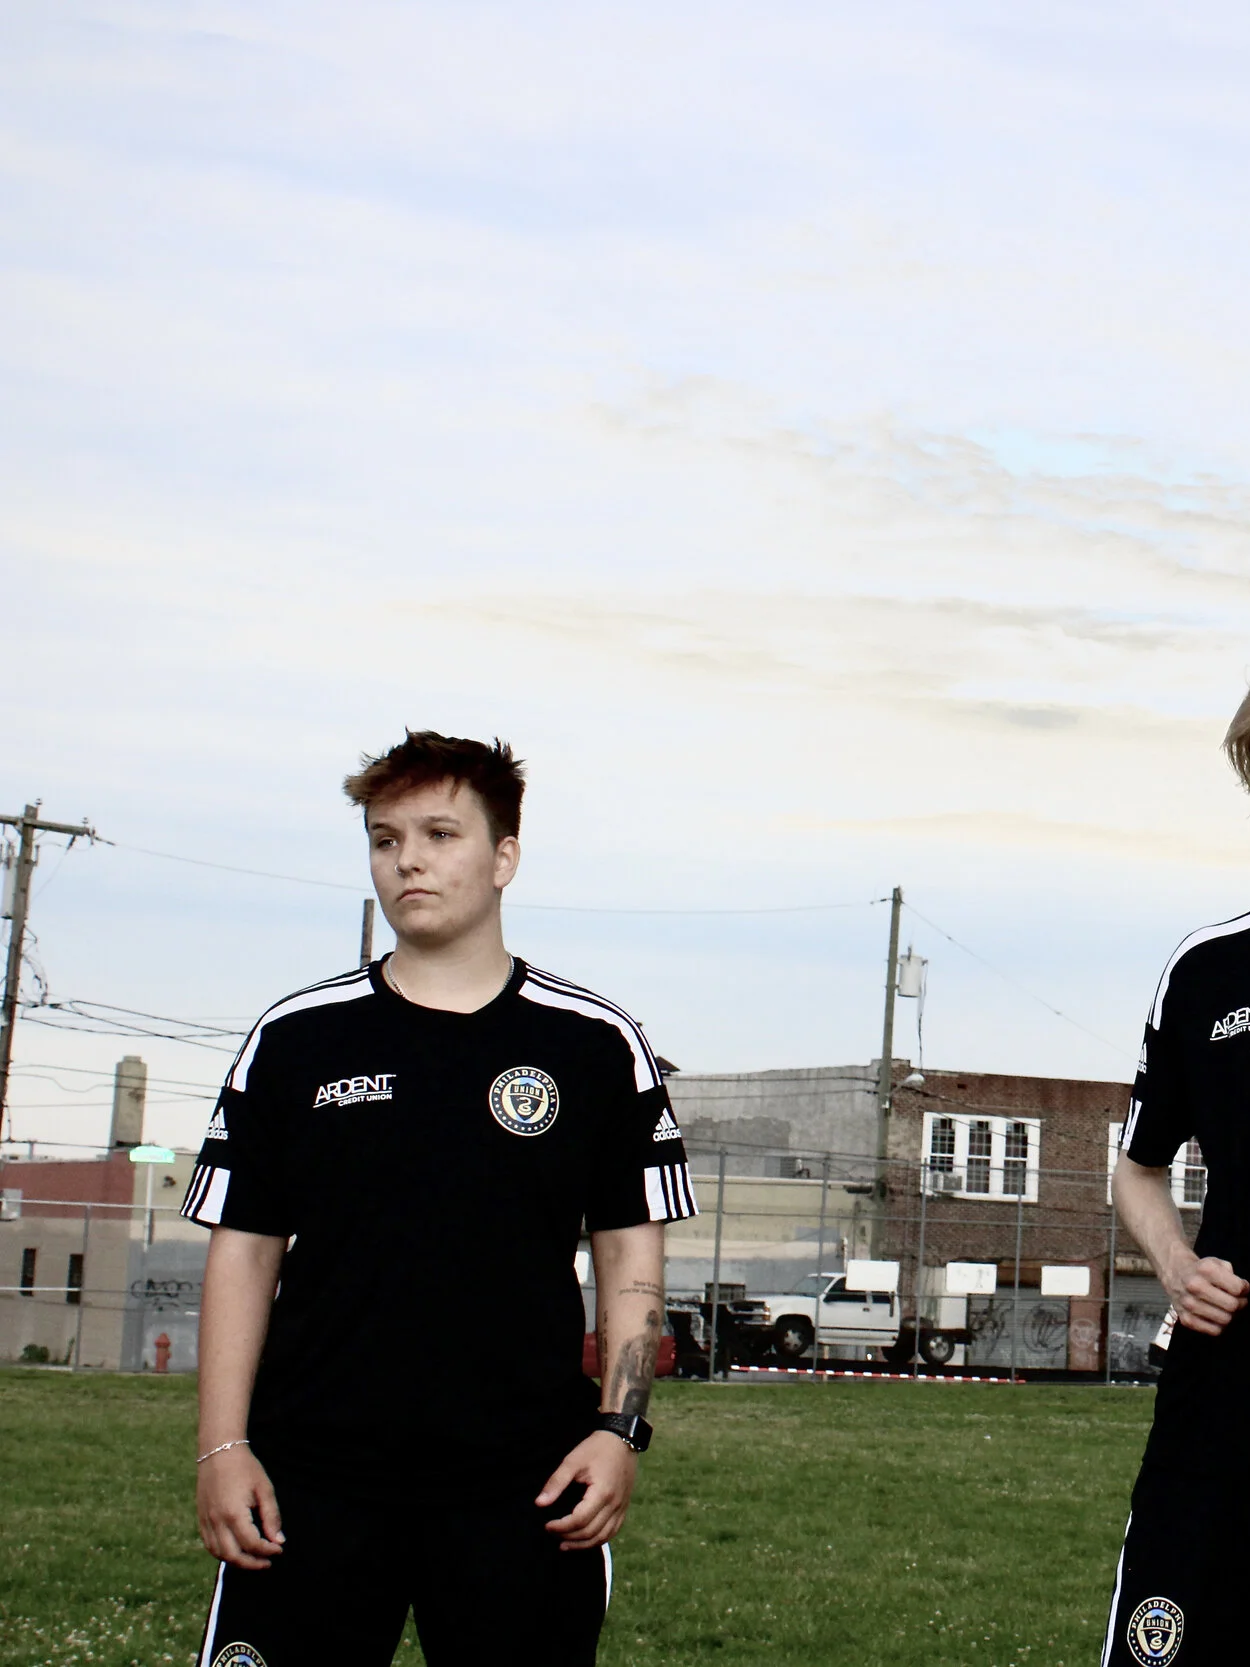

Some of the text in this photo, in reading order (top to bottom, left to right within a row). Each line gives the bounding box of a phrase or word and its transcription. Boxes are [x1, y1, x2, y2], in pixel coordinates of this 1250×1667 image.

[1228, 1025, 1247, 1038] REDIT
[493, 1069, 557, 1103] PHILADELPHIA
[514, 1085, 541, 1096] UNION
[337, 1093, 393, 1107] CREDIT UNION
[652, 1128, 682, 1142] adidas
[1131, 1600, 1182, 1633] PHILADELPHIA
[1146, 1618, 1170, 1628] UNION
